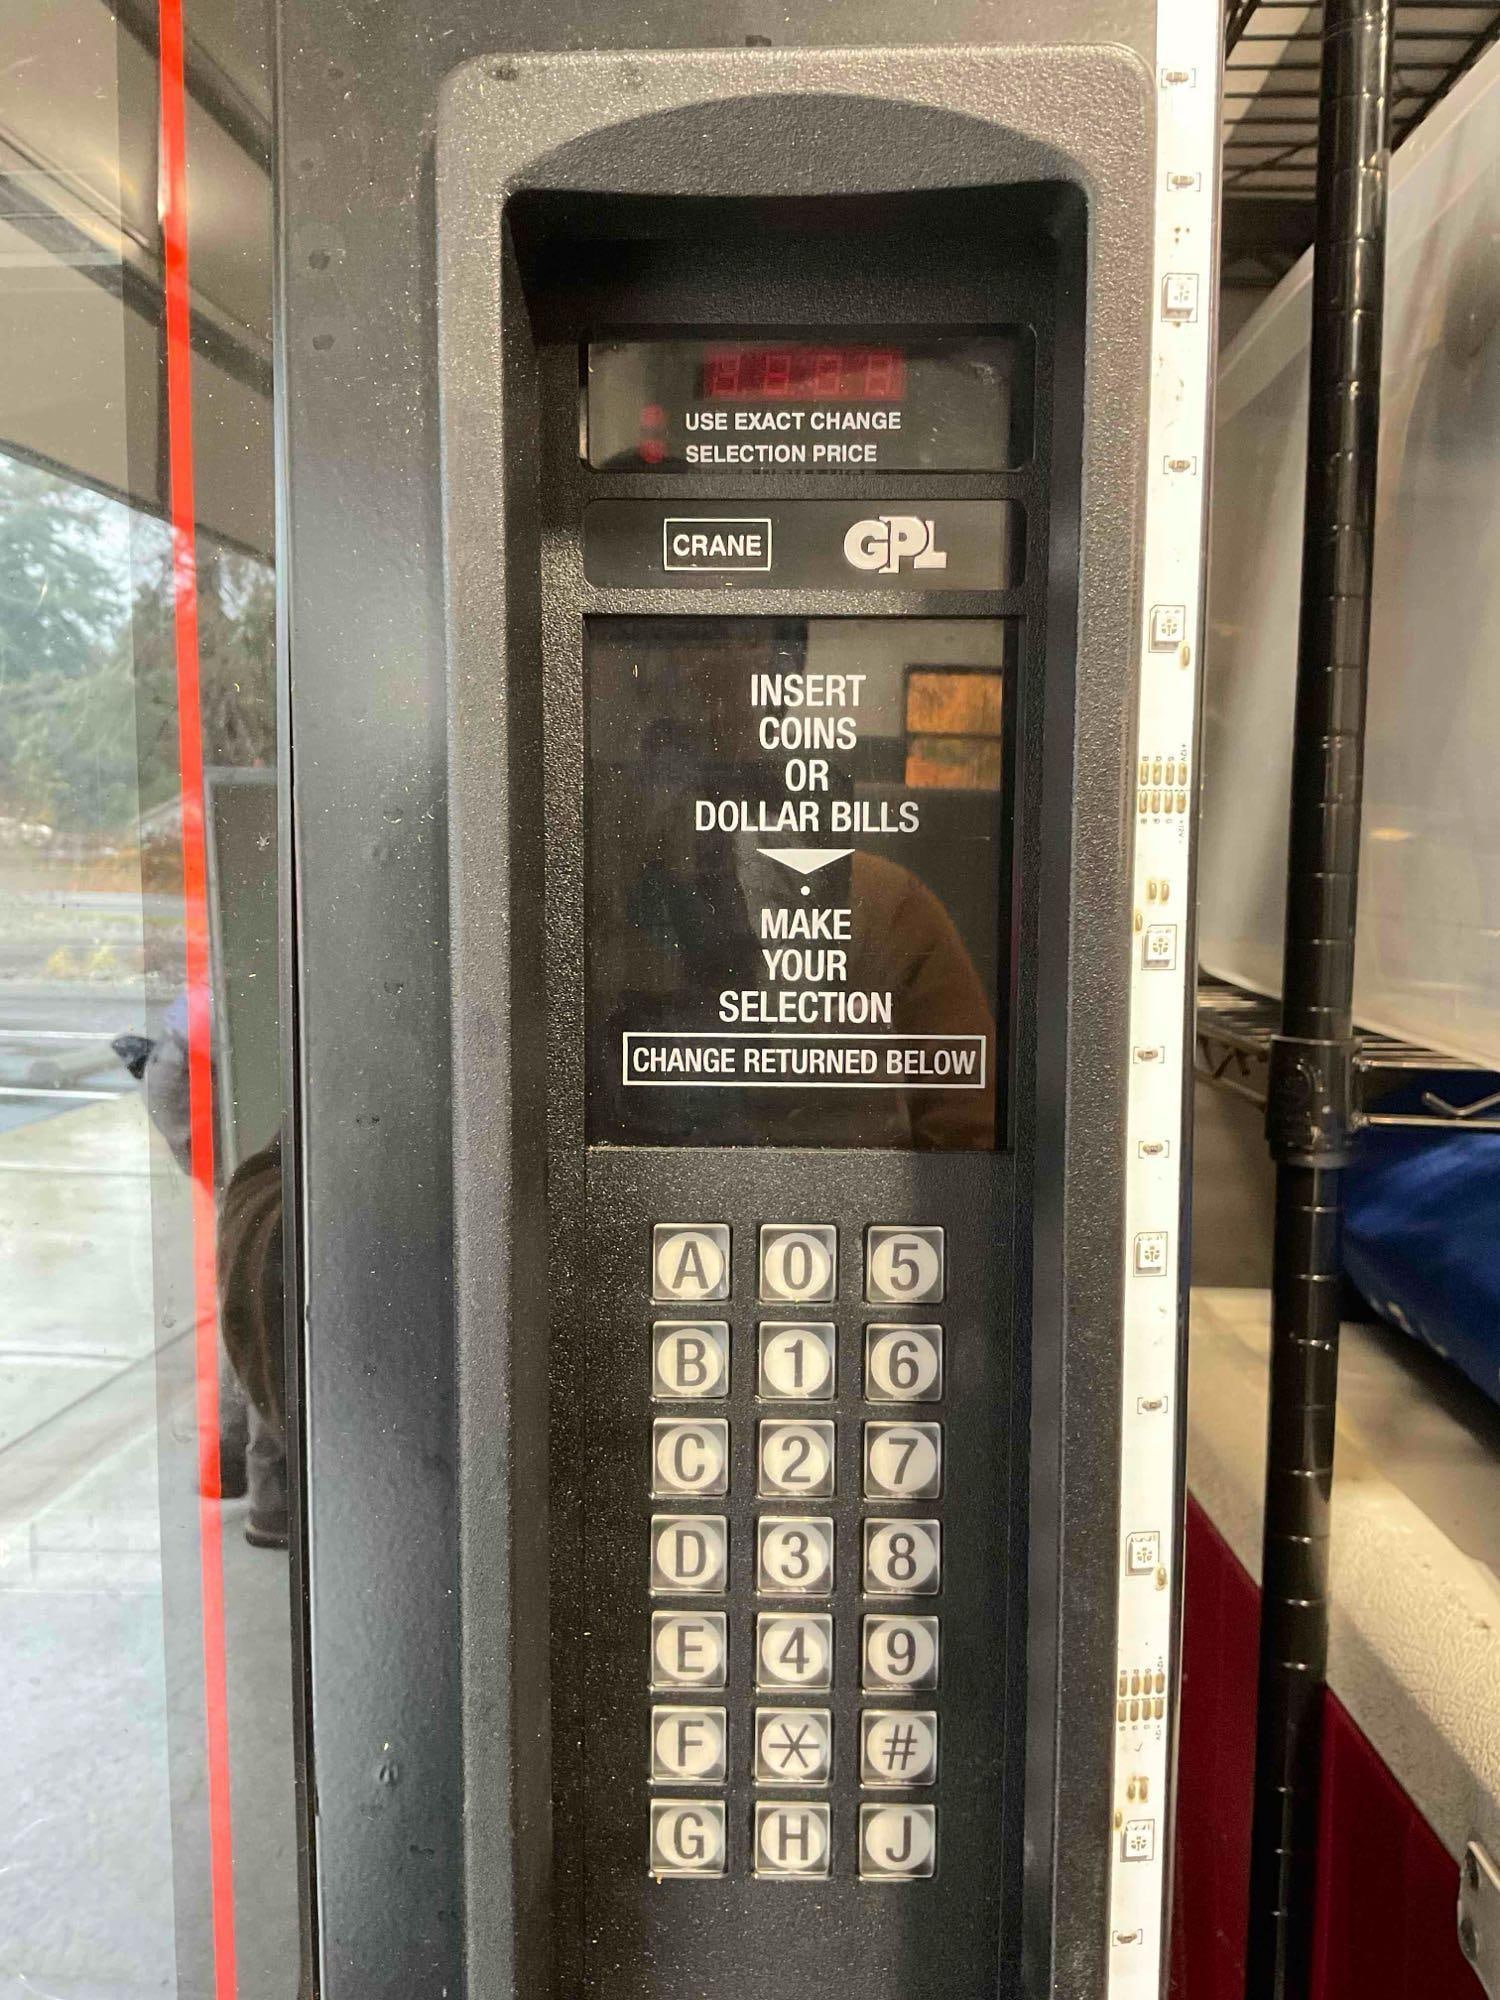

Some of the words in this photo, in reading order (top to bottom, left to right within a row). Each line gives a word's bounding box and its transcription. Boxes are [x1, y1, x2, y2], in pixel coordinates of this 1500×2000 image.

[686, 413, 727, 430] USE
[735, 412, 805, 430] EXACT
[811, 412, 901, 430] CHANGE
[687, 445, 805, 462] SELECTION
[813, 445, 876, 462] PRICE
[673, 535, 761, 556] CRANE
[844, 516, 946, 573] GPL
[752, 674, 866, 706] INSERT
[760, 717, 856, 749] COINS
[785, 759, 828, 791] OR
[696, 801, 819, 832] DOLLAR
[832, 802, 919, 832] BILLS
[762, 909, 851, 939] MAKE
[762, 949, 846, 981] YOUR
[719, 991, 891, 1023] SELECTION
[634, 1048, 735, 1072] CHANGE
[745, 1049, 877, 1073] RETURNED
[887, 1050, 976, 1074] BELOW
[672, 1240, 709, 1290] A
[781, 1240, 814, 1291] 0
[888, 1242, 920, 1291] 5
[675, 1337, 708, 1387] B
[783, 1339, 805, 1388] 1
[887, 1339, 920, 1390] 6
[672, 1432, 706, 1483] C
[779, 1434, 812, 1484] 2
[887, 1437, 919, 1486] 7
[674, 1529, 707, 1578] D
[780, 1530, 810, 1580] 3
[887, 1533, 917, 1581] 8
[676, 1625, 705, 1673] E
[779, 1626, 810, 1674] 4
[885, 1628, 917, 1676] 9
[676, 1719, 705, 1767] F
[672, 1812, 705, 1860] G
[777, 1814, 809, 1861] H
[885, 1816, 912, 1863] J
